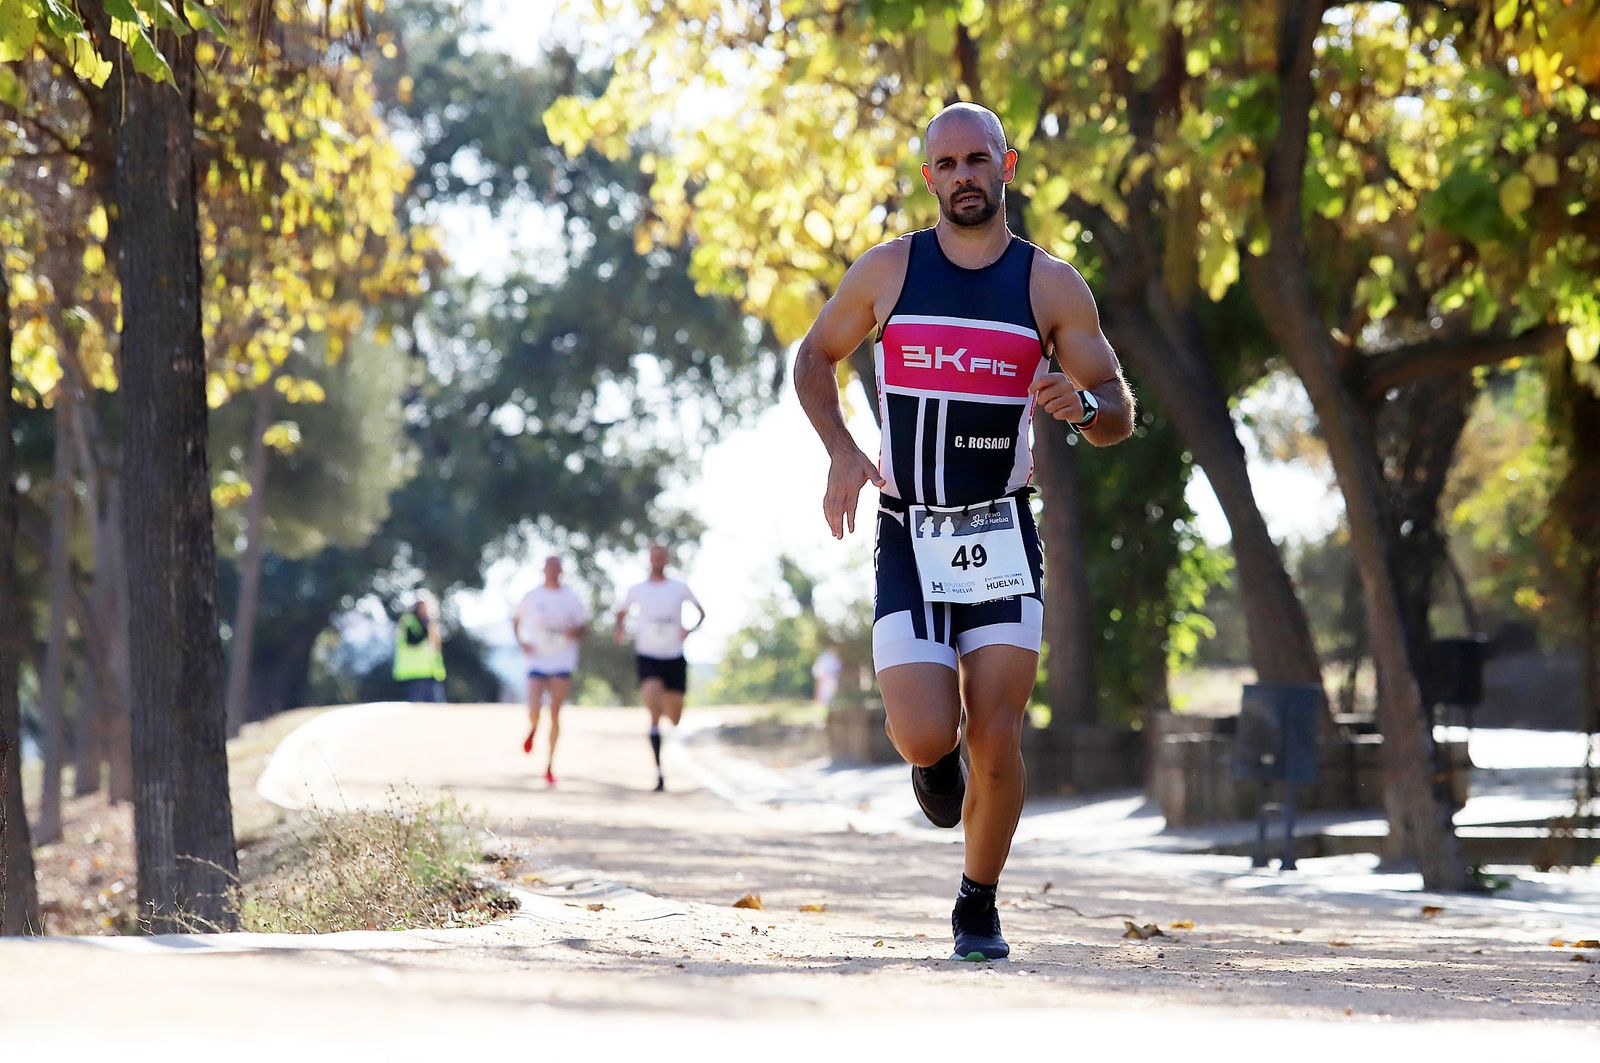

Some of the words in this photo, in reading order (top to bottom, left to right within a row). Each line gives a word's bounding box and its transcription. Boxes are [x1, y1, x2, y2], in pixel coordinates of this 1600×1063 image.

[954, 435, 966, 448] C.
[968, 436, 1010, 449] ROSADO
[951, 543, 988, 571] 49
[986, 578, 1020, 591] HUELVA
